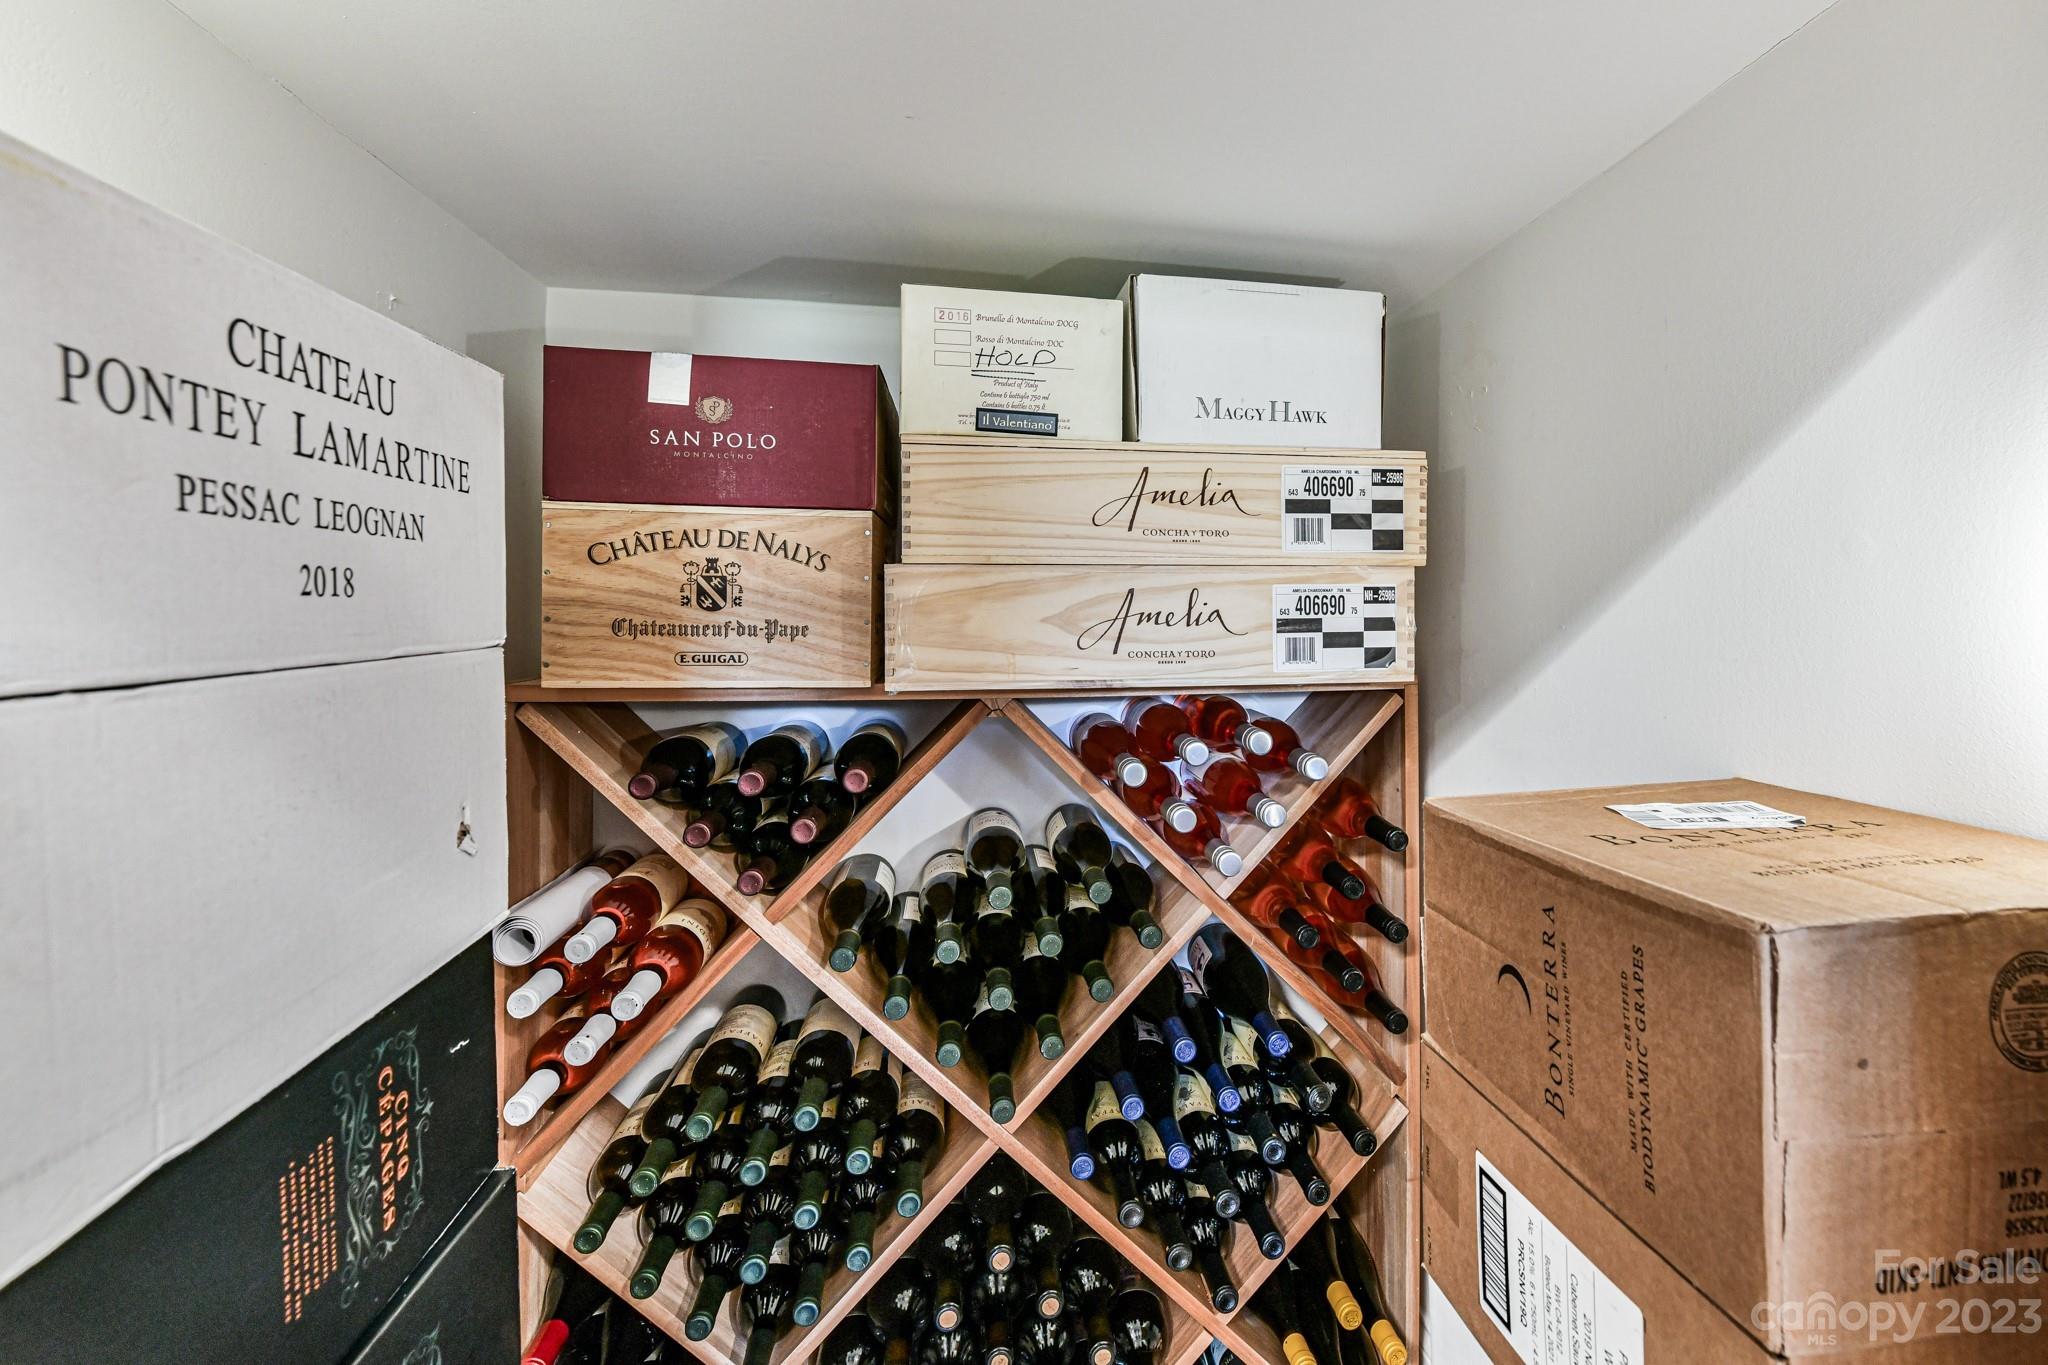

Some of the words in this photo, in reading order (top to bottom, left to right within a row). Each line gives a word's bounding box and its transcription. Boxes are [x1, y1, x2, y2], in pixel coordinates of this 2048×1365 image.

[938, 310, 970, 322] 2016
[976, 313, 1006, 324] Brunello
[1007, 316, 1014, 324] di
[1016, 316, 1055, 327] Montalcino
[1056, 318, 1079, 330] DOCG
[975, 346, 1056, 368] HOLD
[976, 334, 996, 344] Rosso
[997, 336, 1004, 344] di
[1006, 336, 1046, 346] Montalcino
[1047, 339, 1064, 348] DOC
[228, 318, 396, 416] CHATEAU
[993, 378, 1016, 389] Product
[1016, 380, 1024, 390] of
[1024, 382, 1039, 392] Italy
[55, 343, 267, 447] PONTEY
[292, 410, 471, 495] LAMARTINE
[982, 414, 990, 426] Il
[992, 416, 1053, 431] Valentiano
[1195, 396, 1266, 422] MAGGY
[1268, 400, 1328, 424] HAWK
[650, 429, 700, 448] SAN
[712, 432, 776, 450] POLO
[673, 450, 754, 460] MONTALCINO
[1092, 466, 1262, 532] Amelia
[1288, 488, 1299, 496] 643
[1304, 476, 1354, 497] 406690
[1359, 488, 1366, 497] 75
[174, 473, 300, 526] PESSAC
[313, 497, 425, 543] LEOGNAN
[587, 528, 711, 566] CHÂTEAU
[717, 529, 750, 550] DE
[753, 530, 832, 572] NALYS
[1142, 528, 1190, 537] CONCHA
[1200, 530, 1230, 538] TORO
[299, 564, 356, 599] 2018
[1076, 588, 1248, 655] Amelia
[1279, 608, 1290, 616] 643
[1295, 594, 1345, 616] 406690
[1351, 606, 1358, 615] 75
[611, 617, 810, 644] Châteauneuf-du-Pape
[1128, 650, 1175, 659] CONCHA
[1184, 650, 1216, 659] TORO
[1560, 942, 1568, 980] WINES
[1632, 944, 1646, 1032] GRAPES
[1542, 904, 1566, 1120] BONTERRA
[1564, 982, 1574, 1048] VINEYARD
[1620, 970, 1632, 1051] CERTIFIED
[1626, 1058, 1636, 1100] WITH
[394, 1089, 410, 1183] CINQ
[1628, 1108, 1638, 1153] MADE
[1517, 1238, 1528, 1328] PRCSNV19Q
[1570, 1273, 1580, 1333] Cabernet
[1583, 1314, 1592, 1348] 2019
